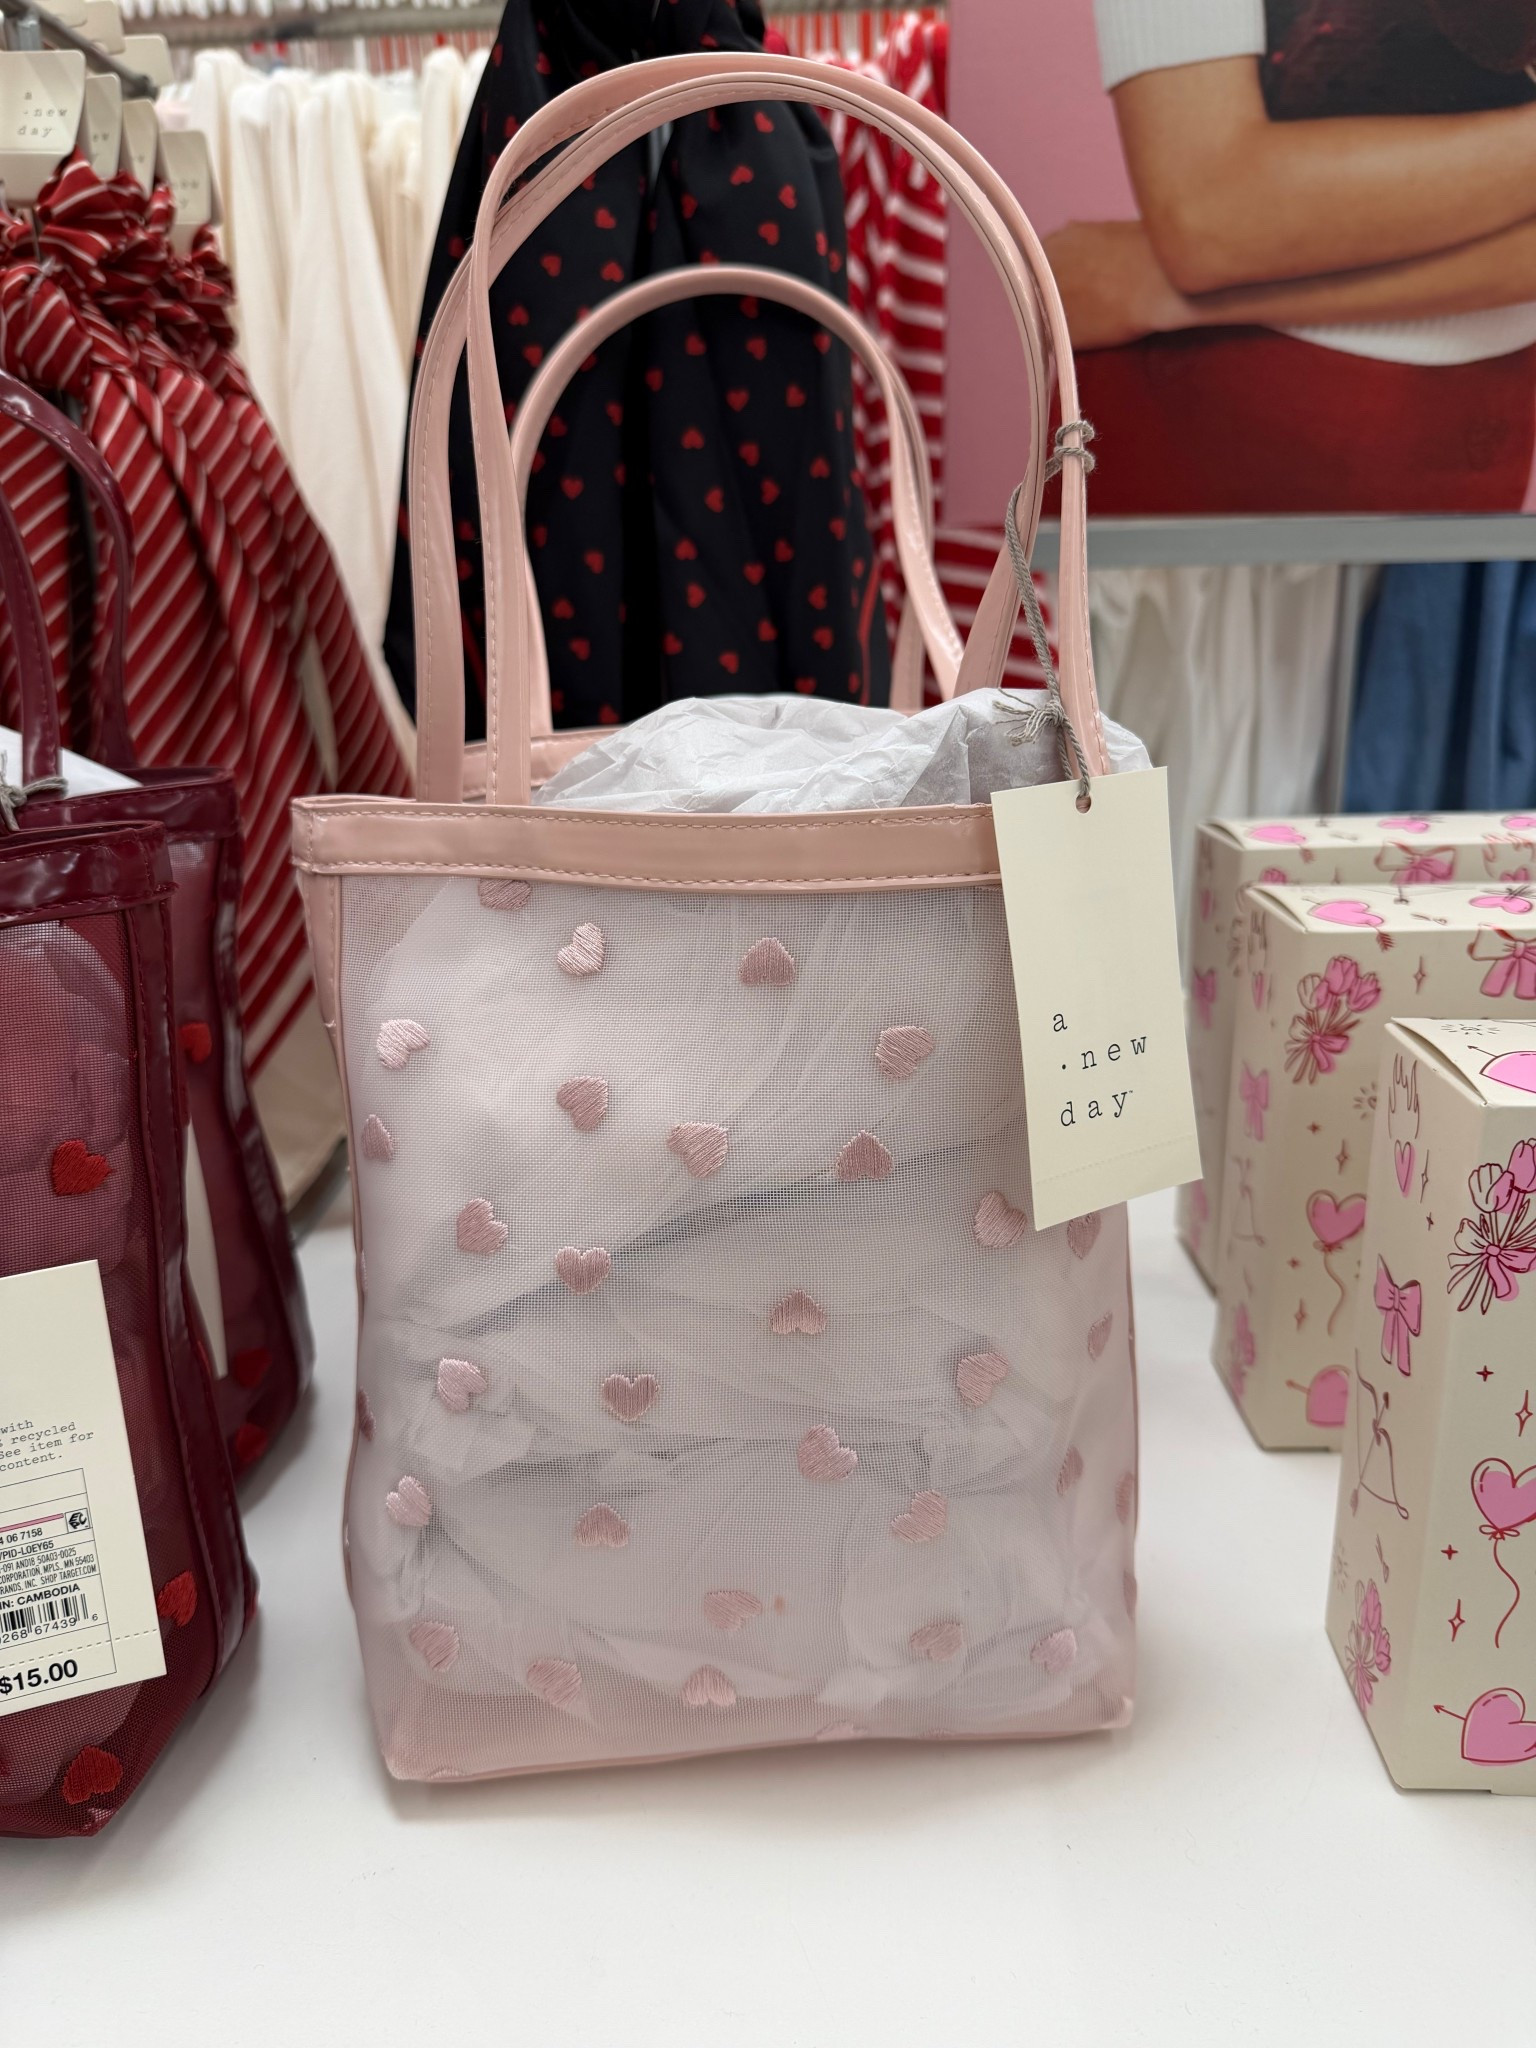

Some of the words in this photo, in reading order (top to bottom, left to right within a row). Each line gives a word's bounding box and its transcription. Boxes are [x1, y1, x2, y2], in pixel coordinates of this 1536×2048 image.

[1052, 1013, 1068, 1032] a
[0, 1420, 34, 1434] with
[11, 1422, 76, 1444] recycled
[30, 1439, 63, 1452] item
[69, 1432, 94, 1443] for
[0, 1452, 62, 1472] content.
[6, 1533, 18, 1543] 06
[20, 1527, 43, 1540] 7158
[64, 1559, 74, 1568] MN
[75, 1554, 94, 1566] 55403
[25, 1579, 38, 1589] INC.
[41, 1573, 57, 1585] SHOP
[59, 1564, 96, 1580] TARGET.COM
[17, 1583, 80, 1605] CAMBODIA
[0, 1629, 28, 1644] 268
[34, 1617, 77, 1635] 67439
[0, 1659, 78, 1694] $15.00
